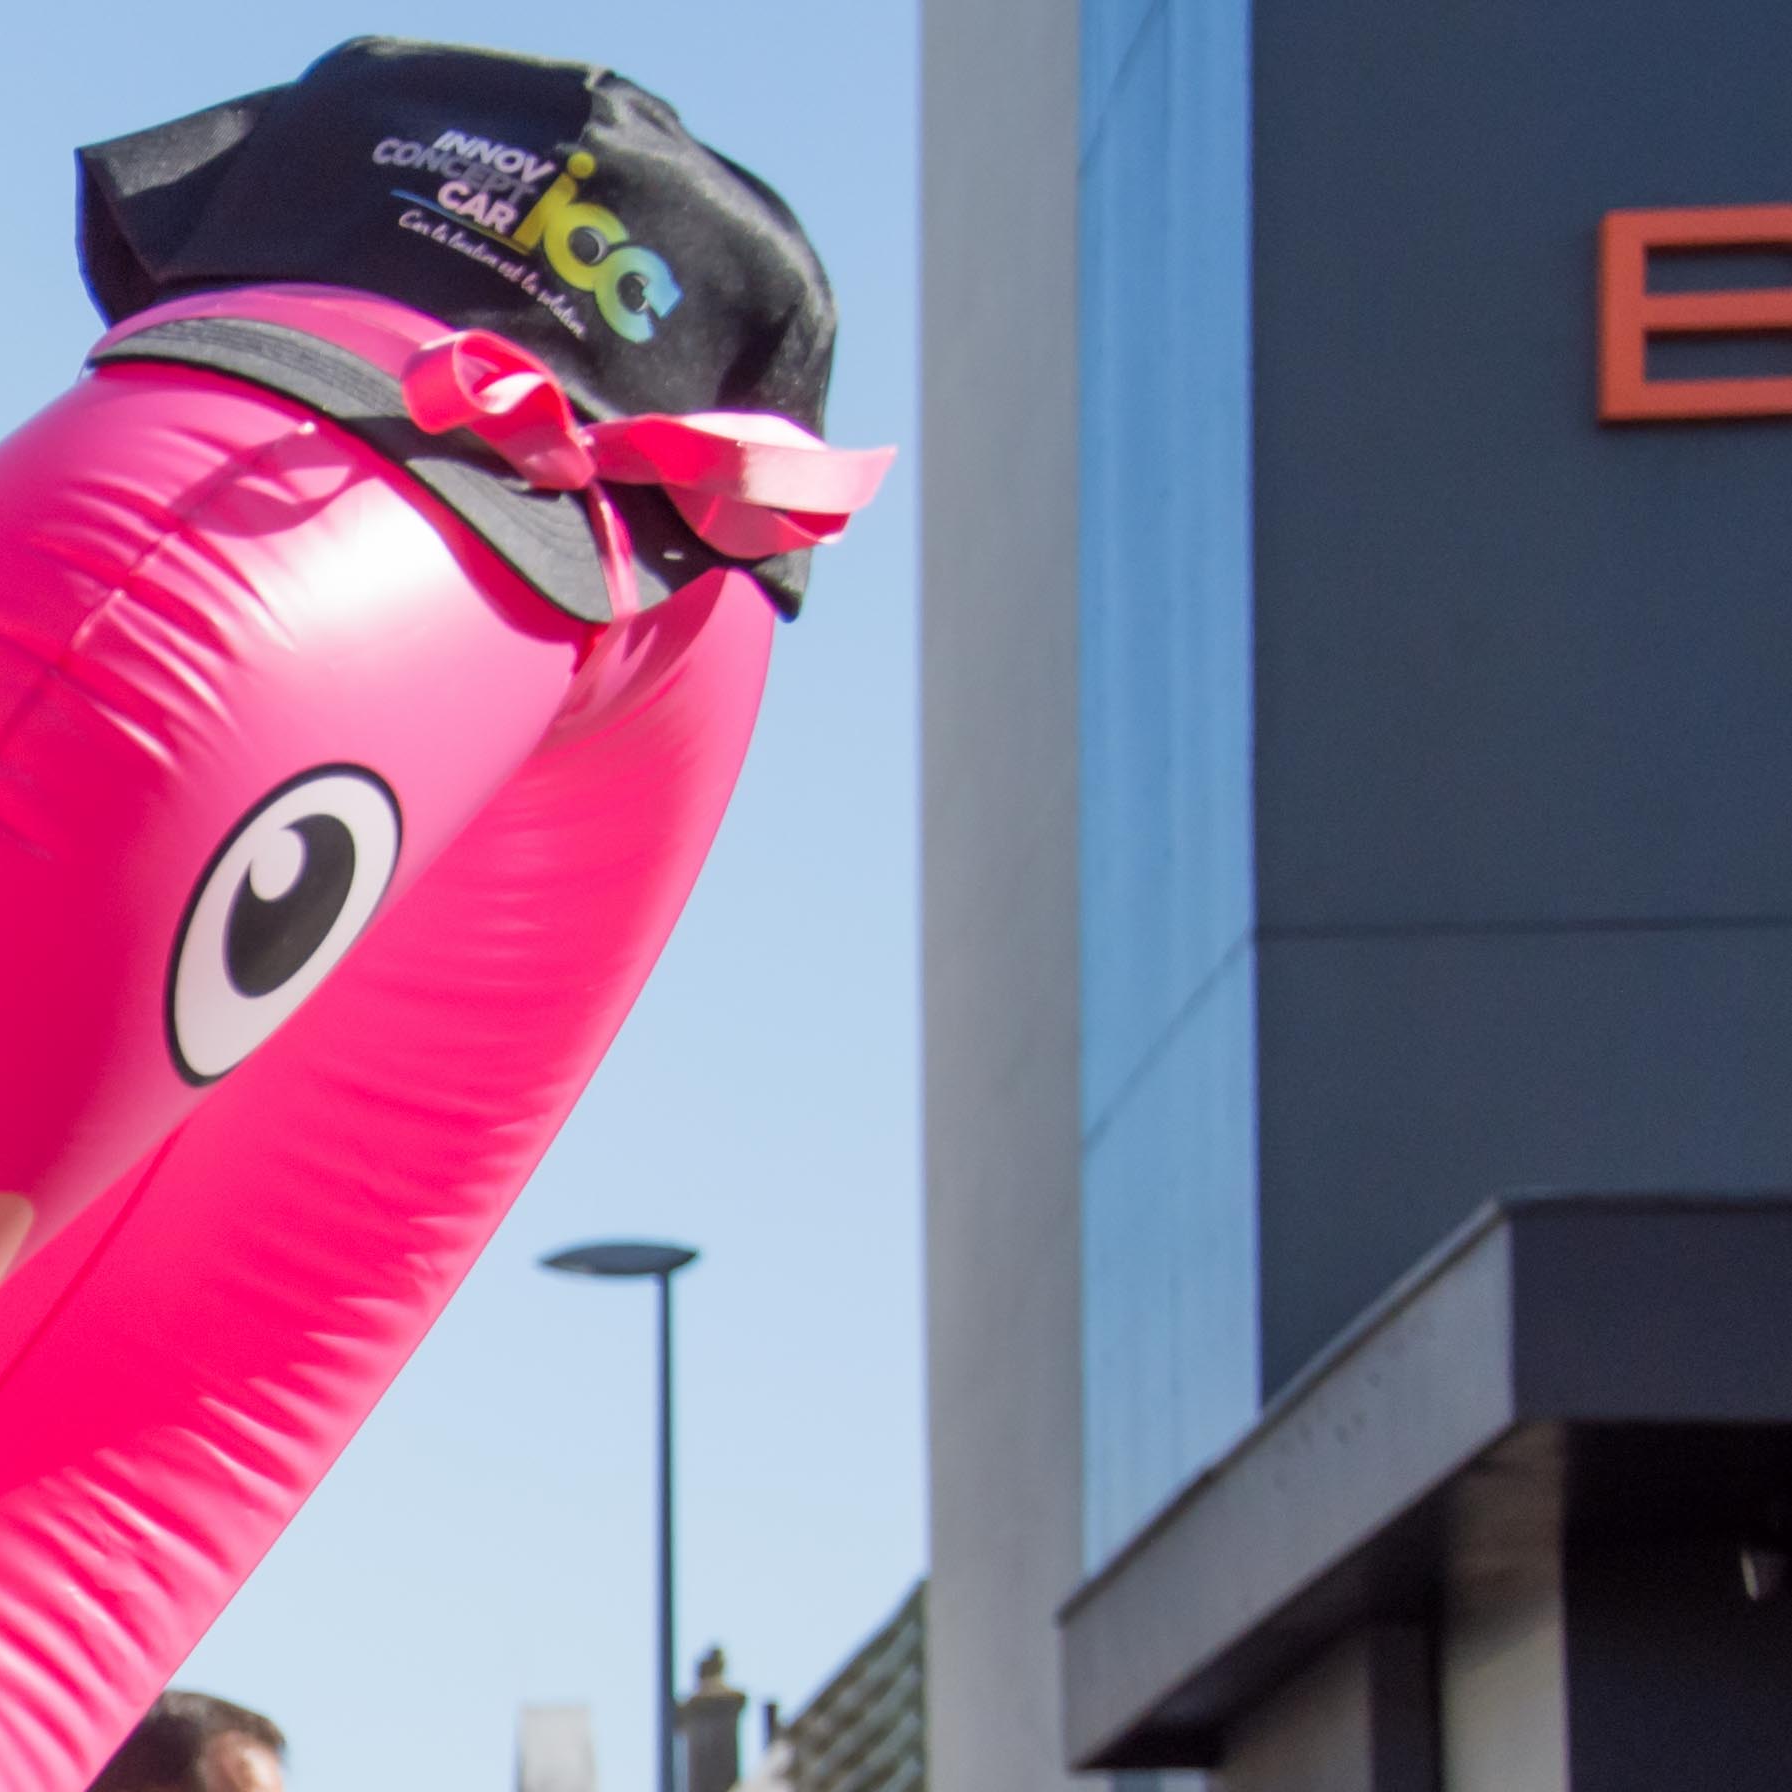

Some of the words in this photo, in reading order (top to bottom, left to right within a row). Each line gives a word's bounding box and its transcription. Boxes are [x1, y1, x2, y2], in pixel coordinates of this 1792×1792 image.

[372, 138, 538, 204] CONCEPT
[432, 130, 556, 183] INNOV
[438, 180, 517, 234] CAR
